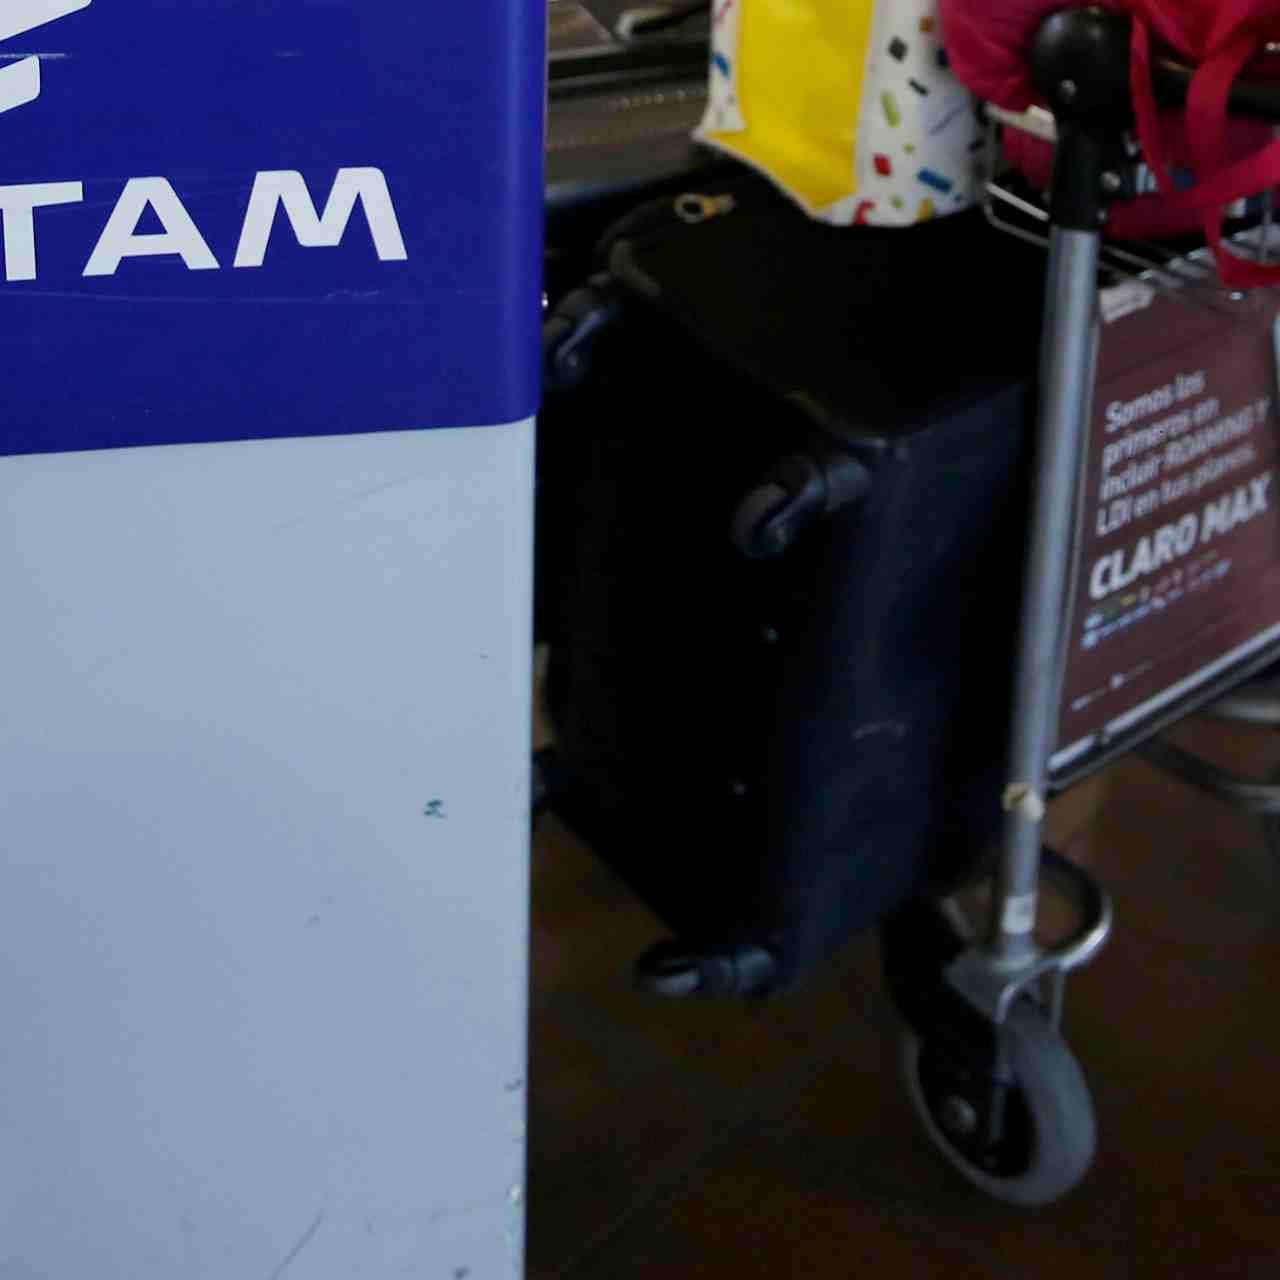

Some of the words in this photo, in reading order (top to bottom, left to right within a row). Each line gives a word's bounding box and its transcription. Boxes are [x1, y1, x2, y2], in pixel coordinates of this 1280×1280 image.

[1105, 383, 1174, 432] Somos
[1102, 408, 1191, 472] primeros
[1089, 513, 1198, 600] CLARO
[1199, 472, 1273, 543] MAX
